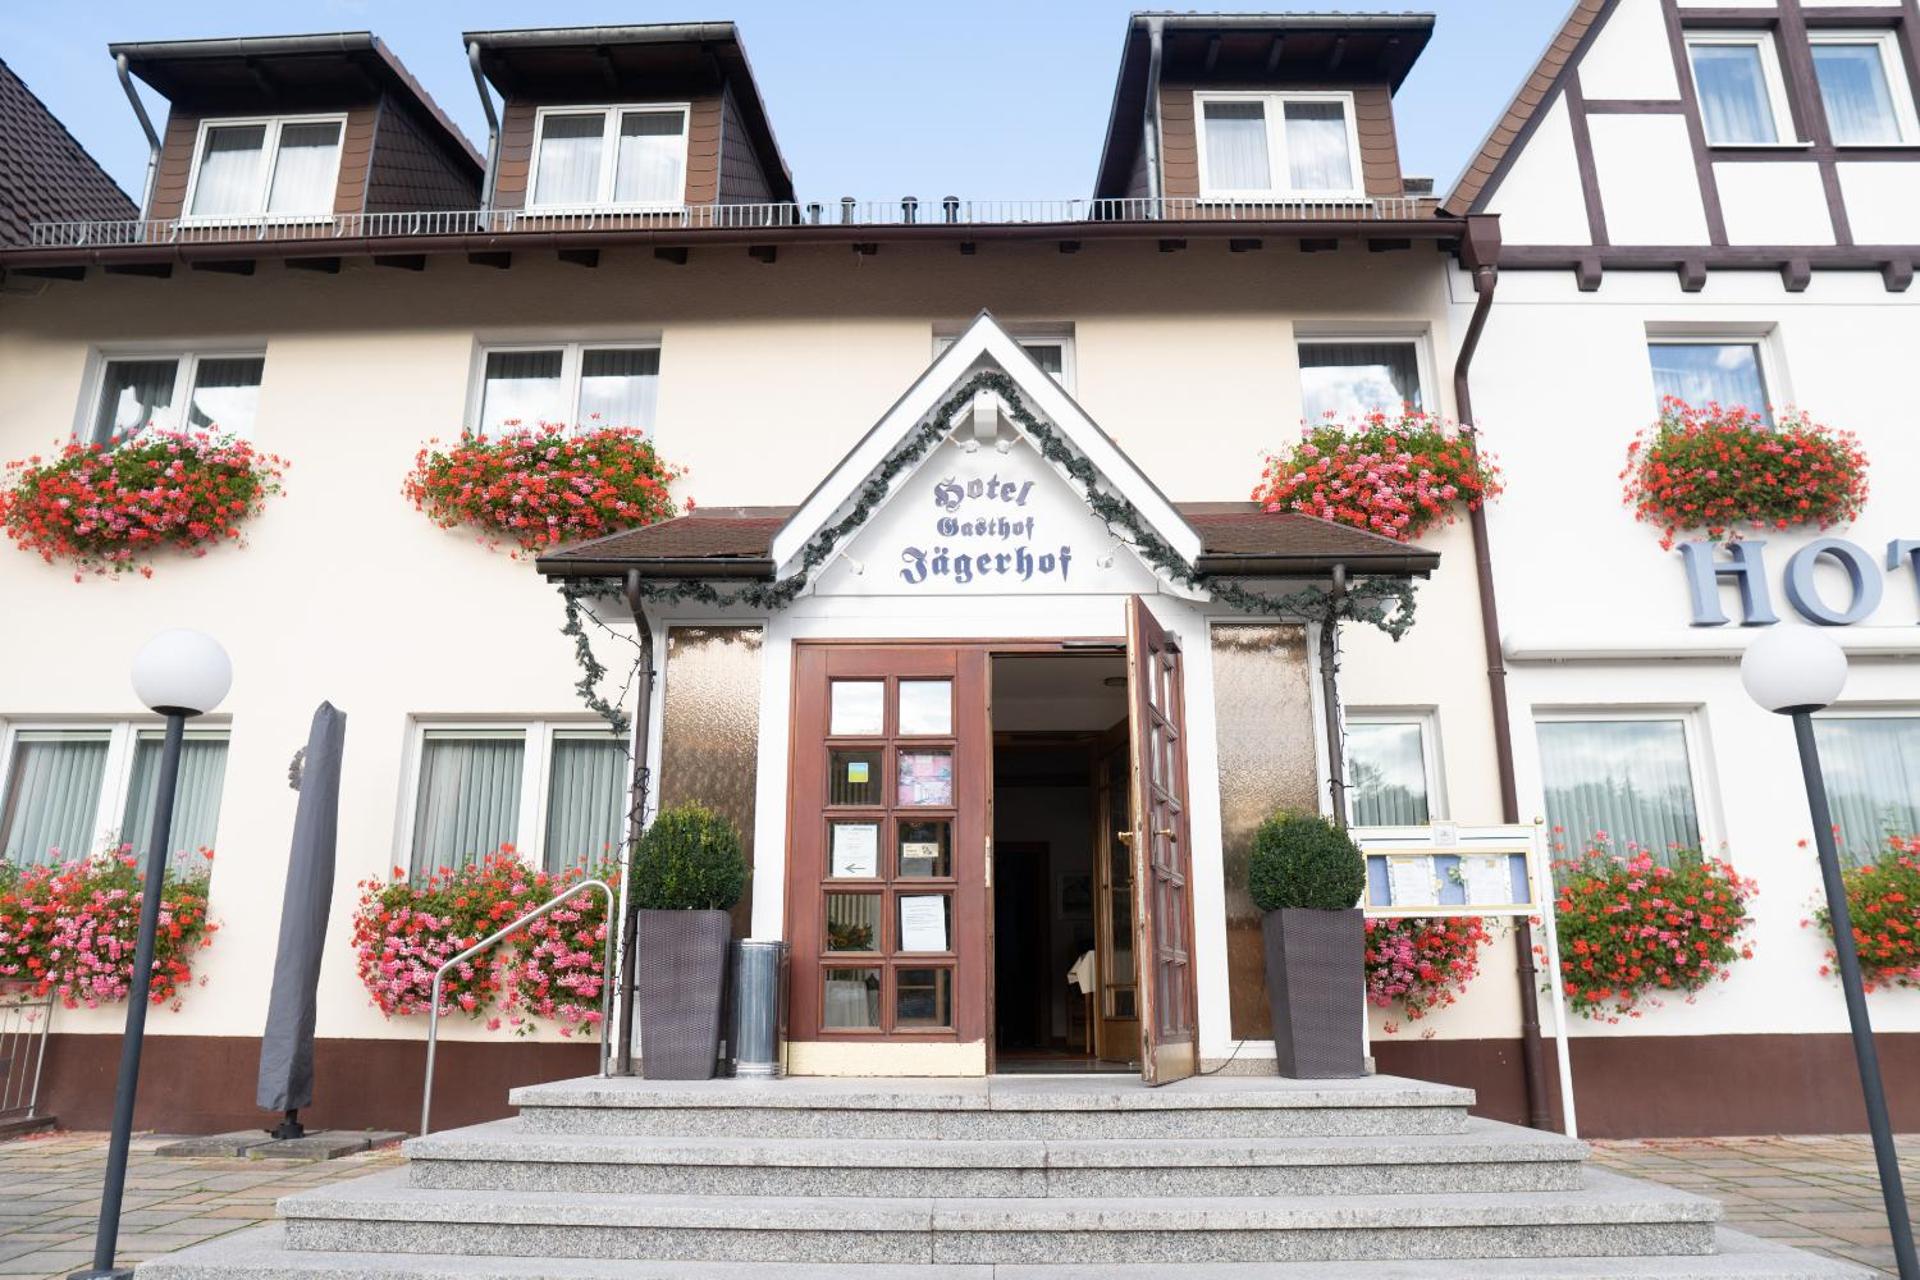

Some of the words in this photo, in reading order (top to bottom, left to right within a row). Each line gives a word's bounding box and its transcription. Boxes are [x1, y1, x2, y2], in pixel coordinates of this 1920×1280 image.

[934, 473, 1035, 512] Hotel
[936, 516, 1034, 540] Gasthof
[900, 545, 1072, 584] Jägerhof
